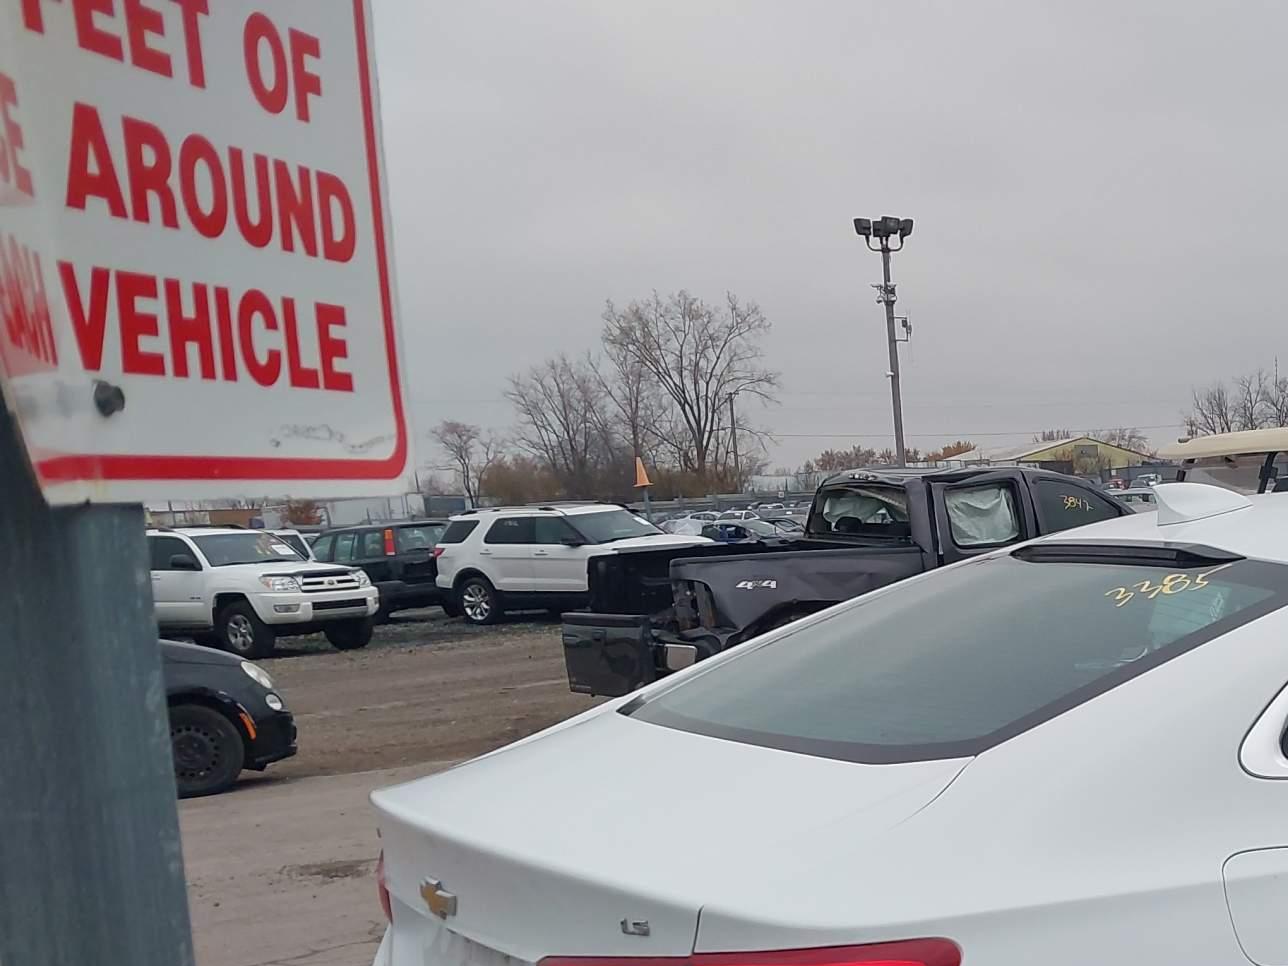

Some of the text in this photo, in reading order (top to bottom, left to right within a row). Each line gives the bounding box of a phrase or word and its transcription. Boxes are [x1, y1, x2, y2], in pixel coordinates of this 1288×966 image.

[243, 11, 323, 123] OF
[66, 101, 357, 263] AROUND
[57, 259, 355, 393] VEHICLE
[1104, 563, 1232, 607] 3385
